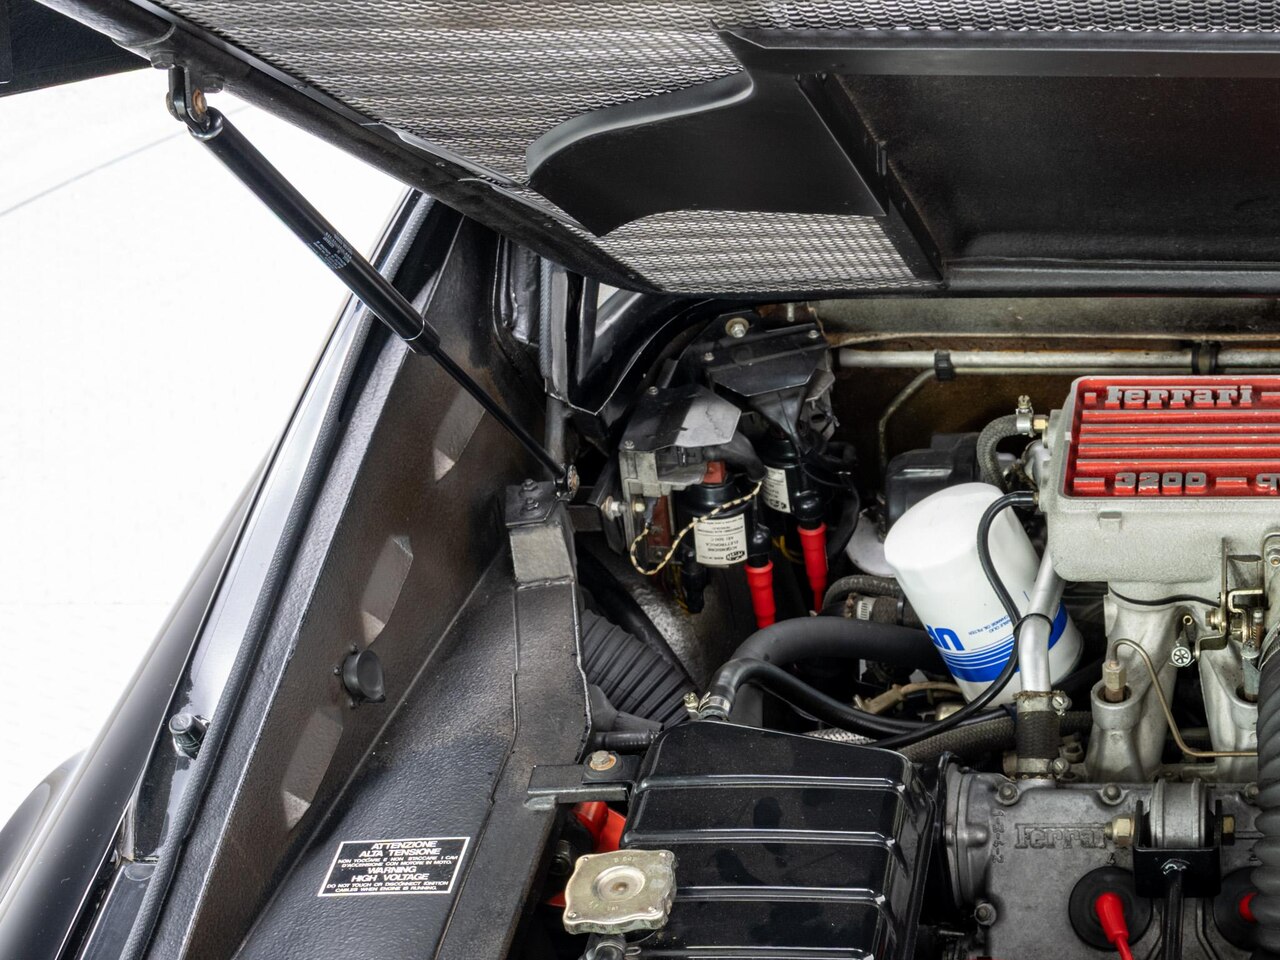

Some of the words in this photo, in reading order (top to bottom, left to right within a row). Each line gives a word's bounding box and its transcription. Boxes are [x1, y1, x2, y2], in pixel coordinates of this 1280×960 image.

[1104, 385, 1253, 408] Ferrari
[1114, 471, 1207, 494] 3200
[1015, 822, 1108, 849] Ferrar
[370, 840, 438, 850] ATTENZIONE
[358, 850, 384, 858] ALTA
[388, 848, 442, 857] TENSIONE
[367, 866, 417, 874] WARNING
[351, 875, 378, 883] HIGH
[383, 873, 430, 882] VOLTAGE
